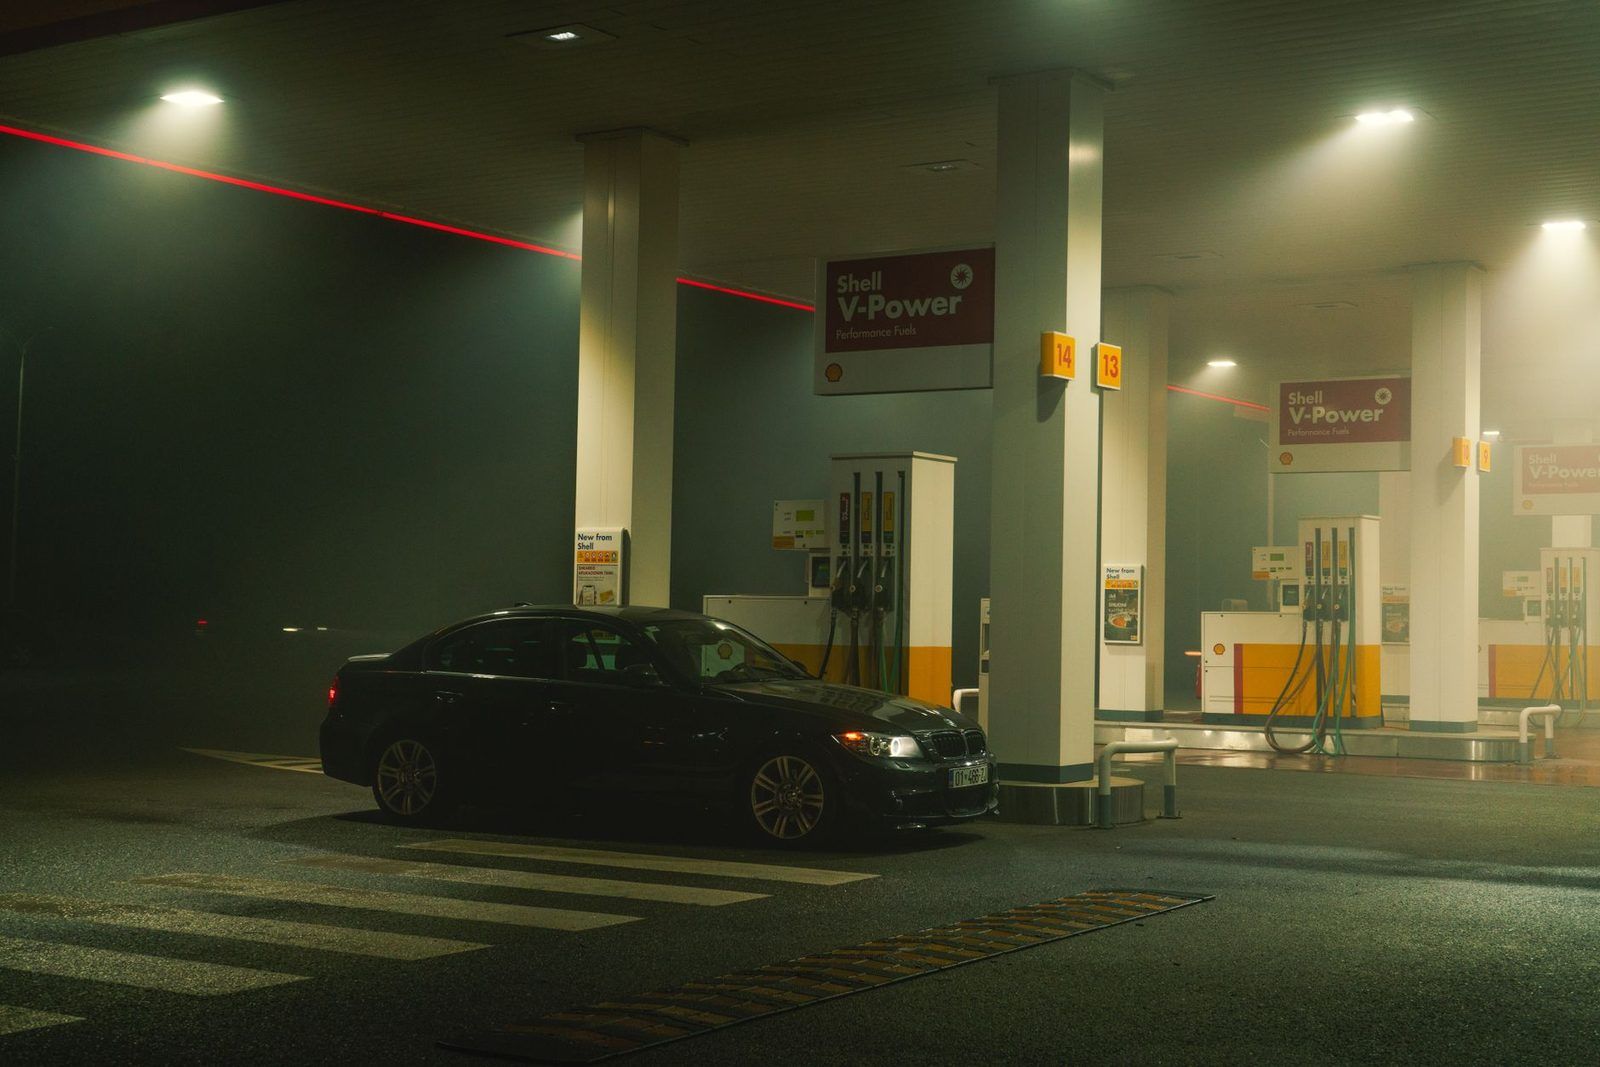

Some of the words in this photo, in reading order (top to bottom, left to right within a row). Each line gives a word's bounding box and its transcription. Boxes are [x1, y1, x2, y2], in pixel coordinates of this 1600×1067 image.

[837, 271, 882, 293] Shell
[837, 294, 962, 322] V-Power
[836, 327, 892, 340] Performance
[894, 323, 917, 337] Fuels
[1056, 343, 1072, 368] 14
[1103, 354, 1118, 378] 13
[1288, 391, 1323, 405] Shell
[1289, 406, 1384, 424] V-Power
[1528, 453, 1557, 465] Shell
[578, 533, 594, 541] New
[596, 533, 612, 541] from
[577, 542, 594, 550] Shell
